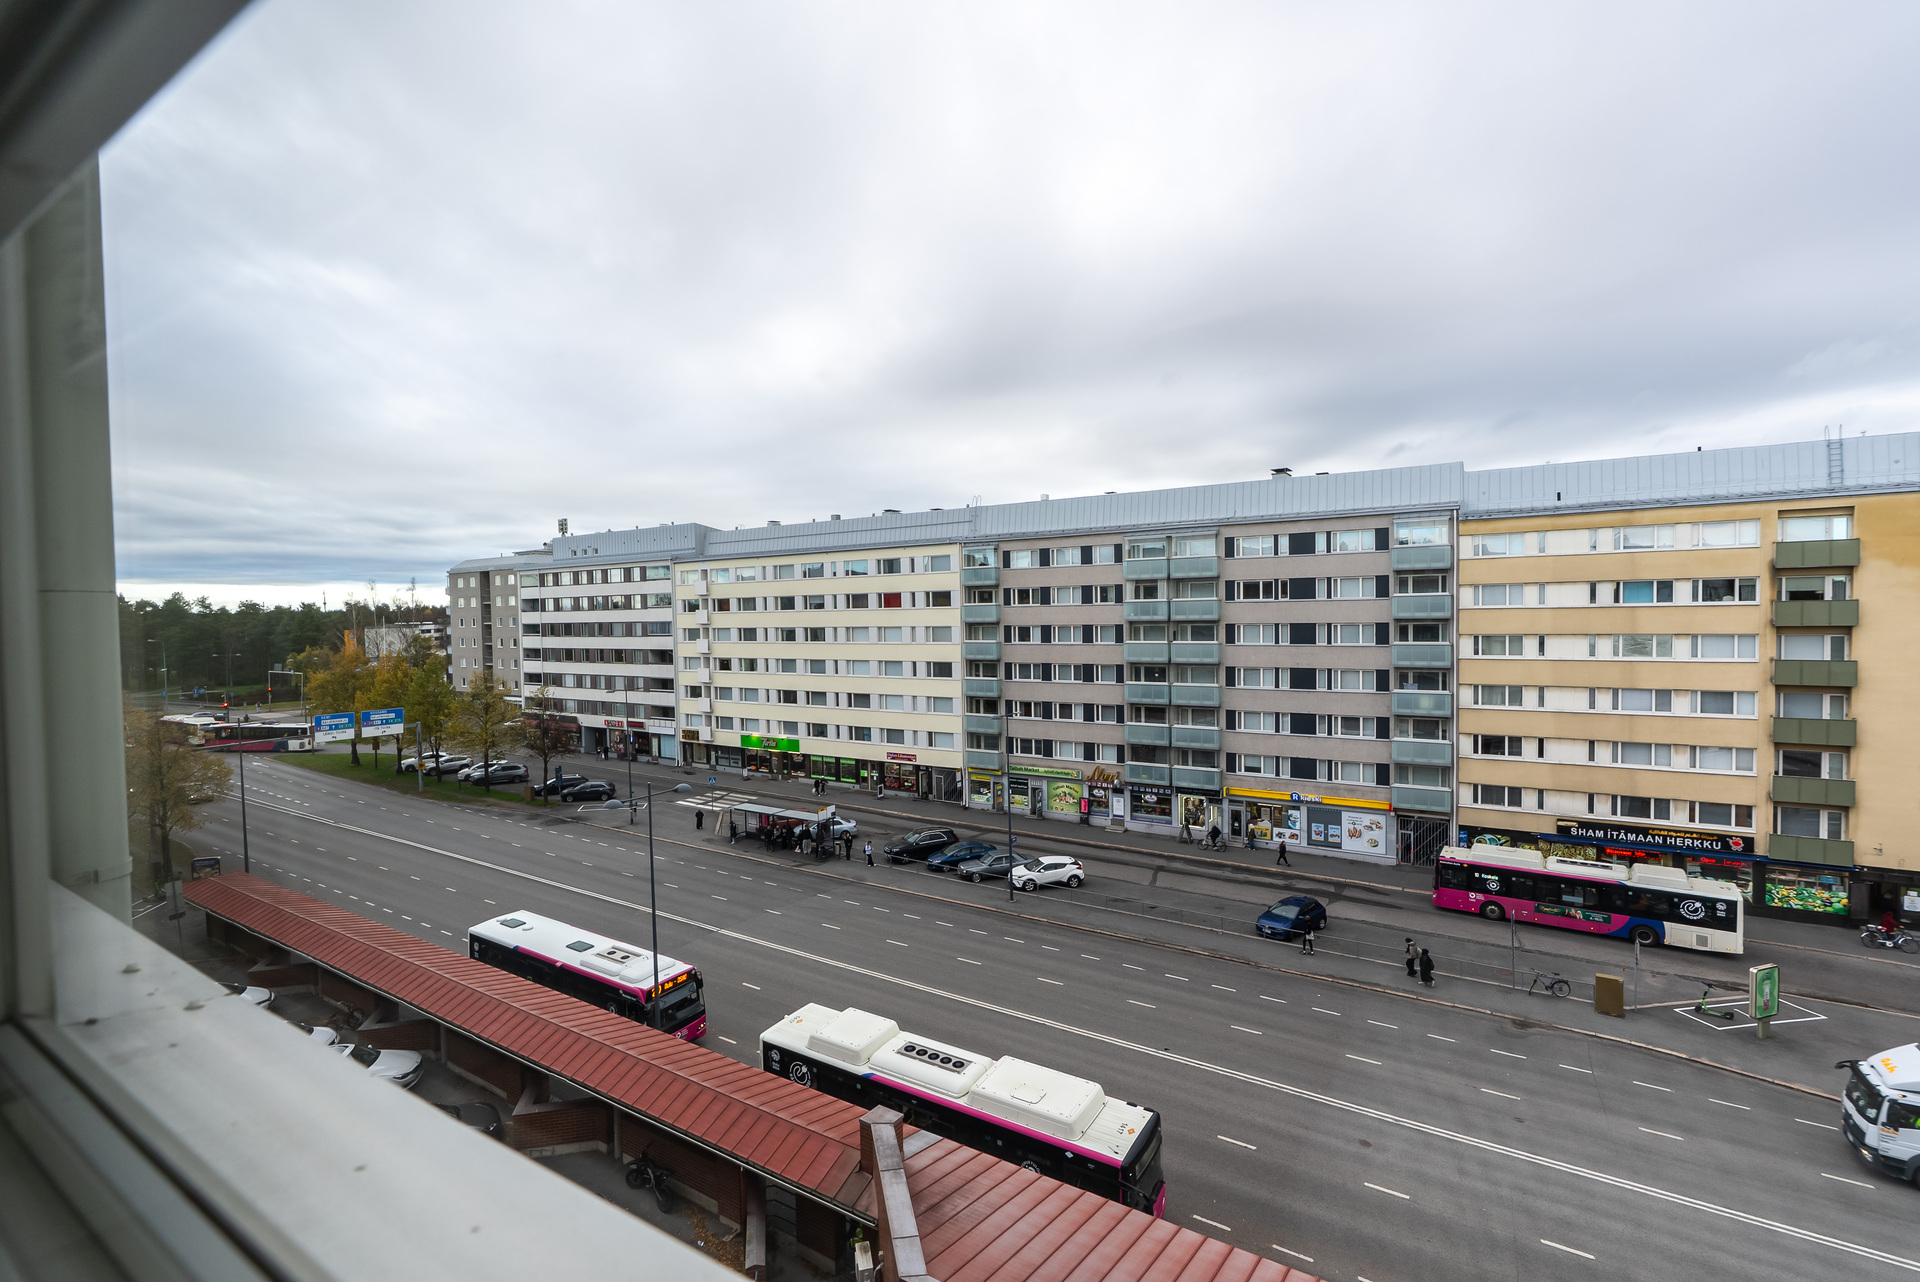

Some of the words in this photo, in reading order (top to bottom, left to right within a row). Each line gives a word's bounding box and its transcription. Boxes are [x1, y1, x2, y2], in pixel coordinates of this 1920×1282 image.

[1300, 794, 1322, 802] kioski
[1570, 827, 1604, 838] SHAM
[1667, 838, 1722, 850] HERKKU
